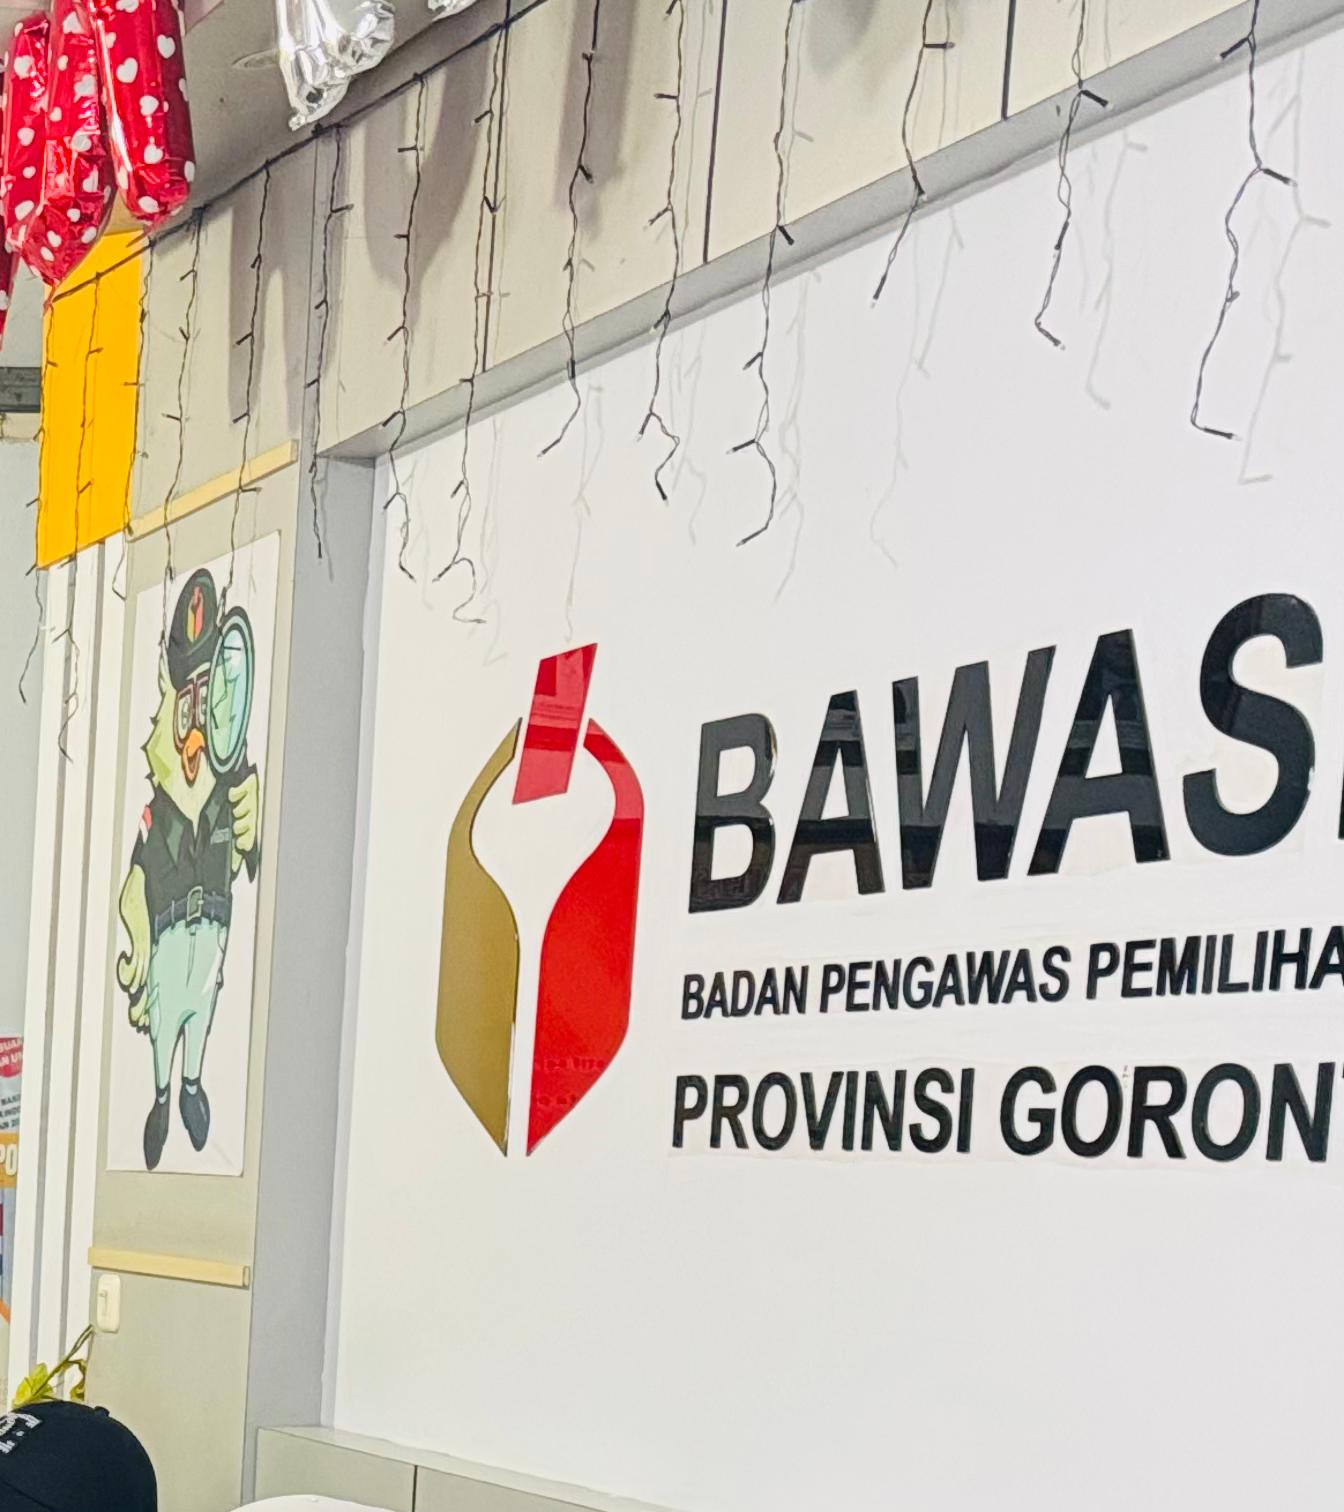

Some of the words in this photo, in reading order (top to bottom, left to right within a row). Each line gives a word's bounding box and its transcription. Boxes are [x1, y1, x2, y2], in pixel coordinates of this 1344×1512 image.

[688, 592, 1344, 913] BAWAS
[680, 964, 808, 1021] BADAN
[819, 946, 1071, 1014] PENGAWAS
[671, 1067, 975, 1156] PROVINSI
[1000, 1061, 1344, 1164] GORON
